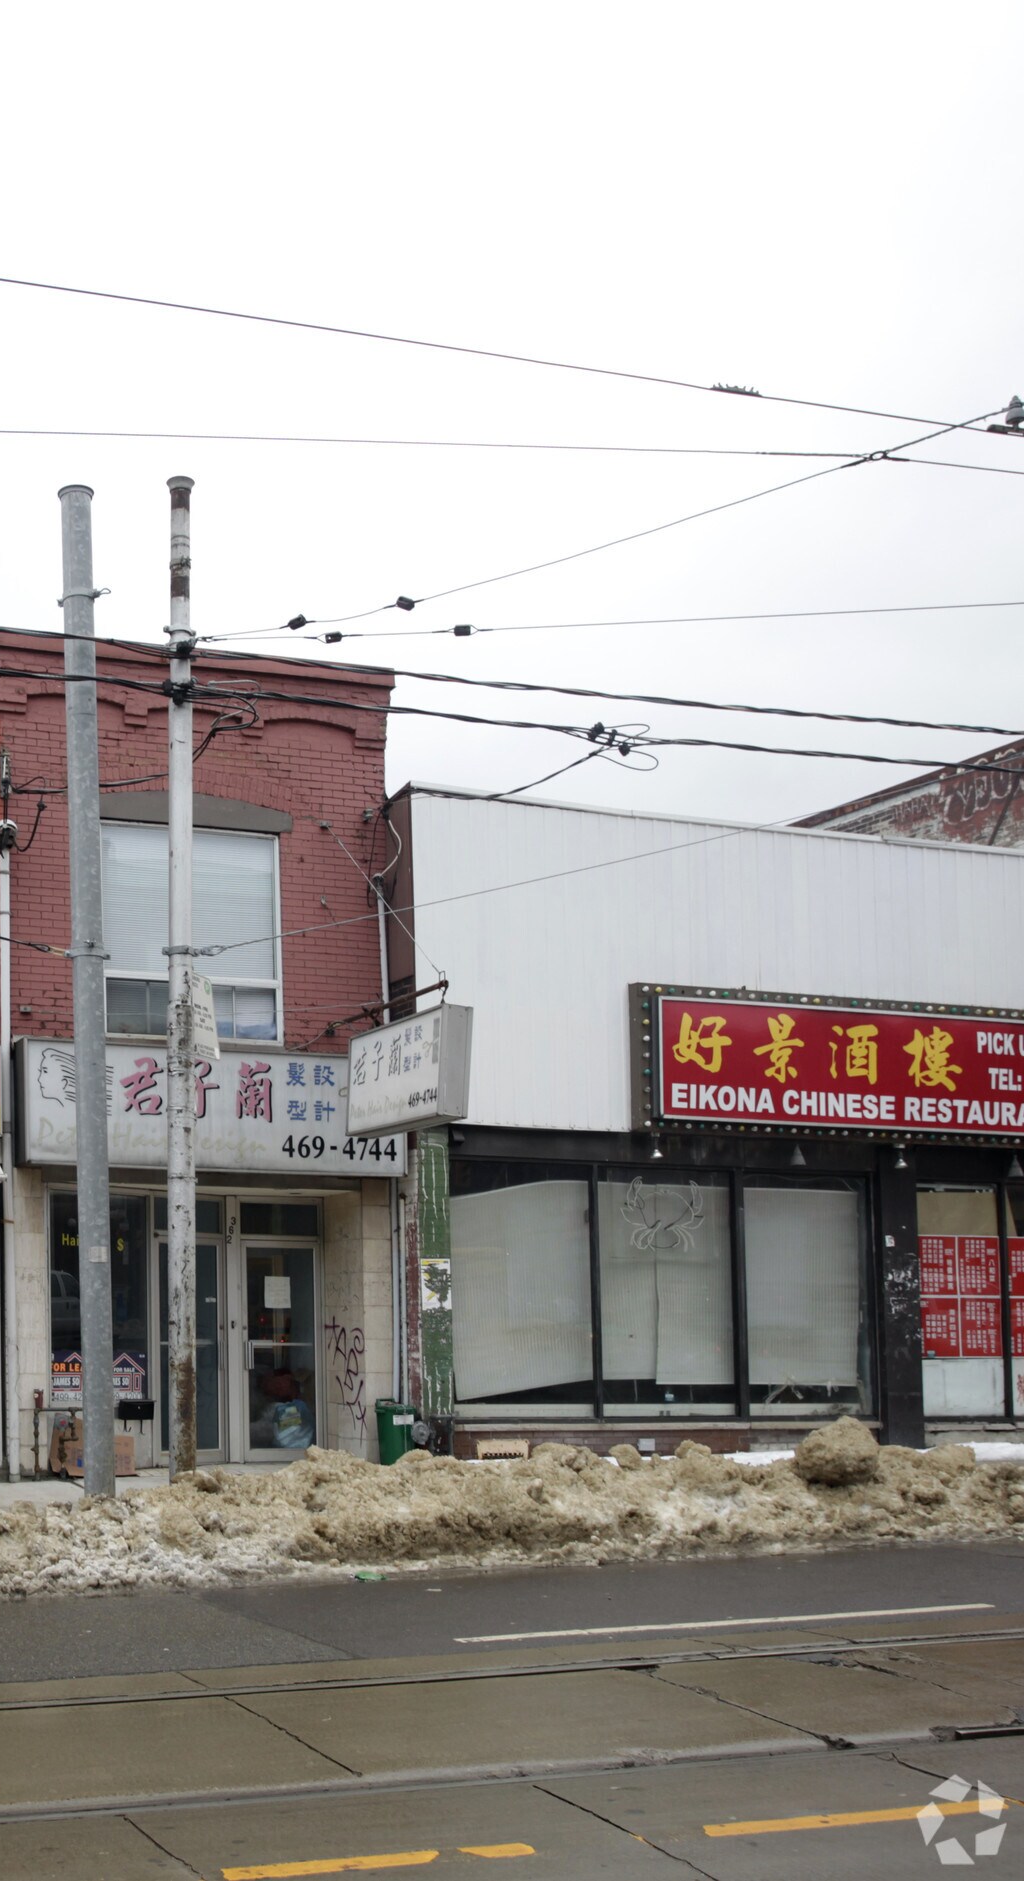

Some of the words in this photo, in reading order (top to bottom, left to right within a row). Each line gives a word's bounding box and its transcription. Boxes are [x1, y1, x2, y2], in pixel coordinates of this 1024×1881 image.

[672, 1012, 963, 1091] 好景酒樓
[977, 1031, 1015, 1056] PICK
[988, 1067, 1022, 1091] TEL:
[671, 1083, 775, 1115] EIKONA
[782, 1089, 896, 1121] CHINESE
[194, 1129, 266, 1162] esign
[282, 1135, 398, 1162] 469-4744
[227, 1216, 237, 1244] 362
[53, 1376, 71, 1386] JAMES
